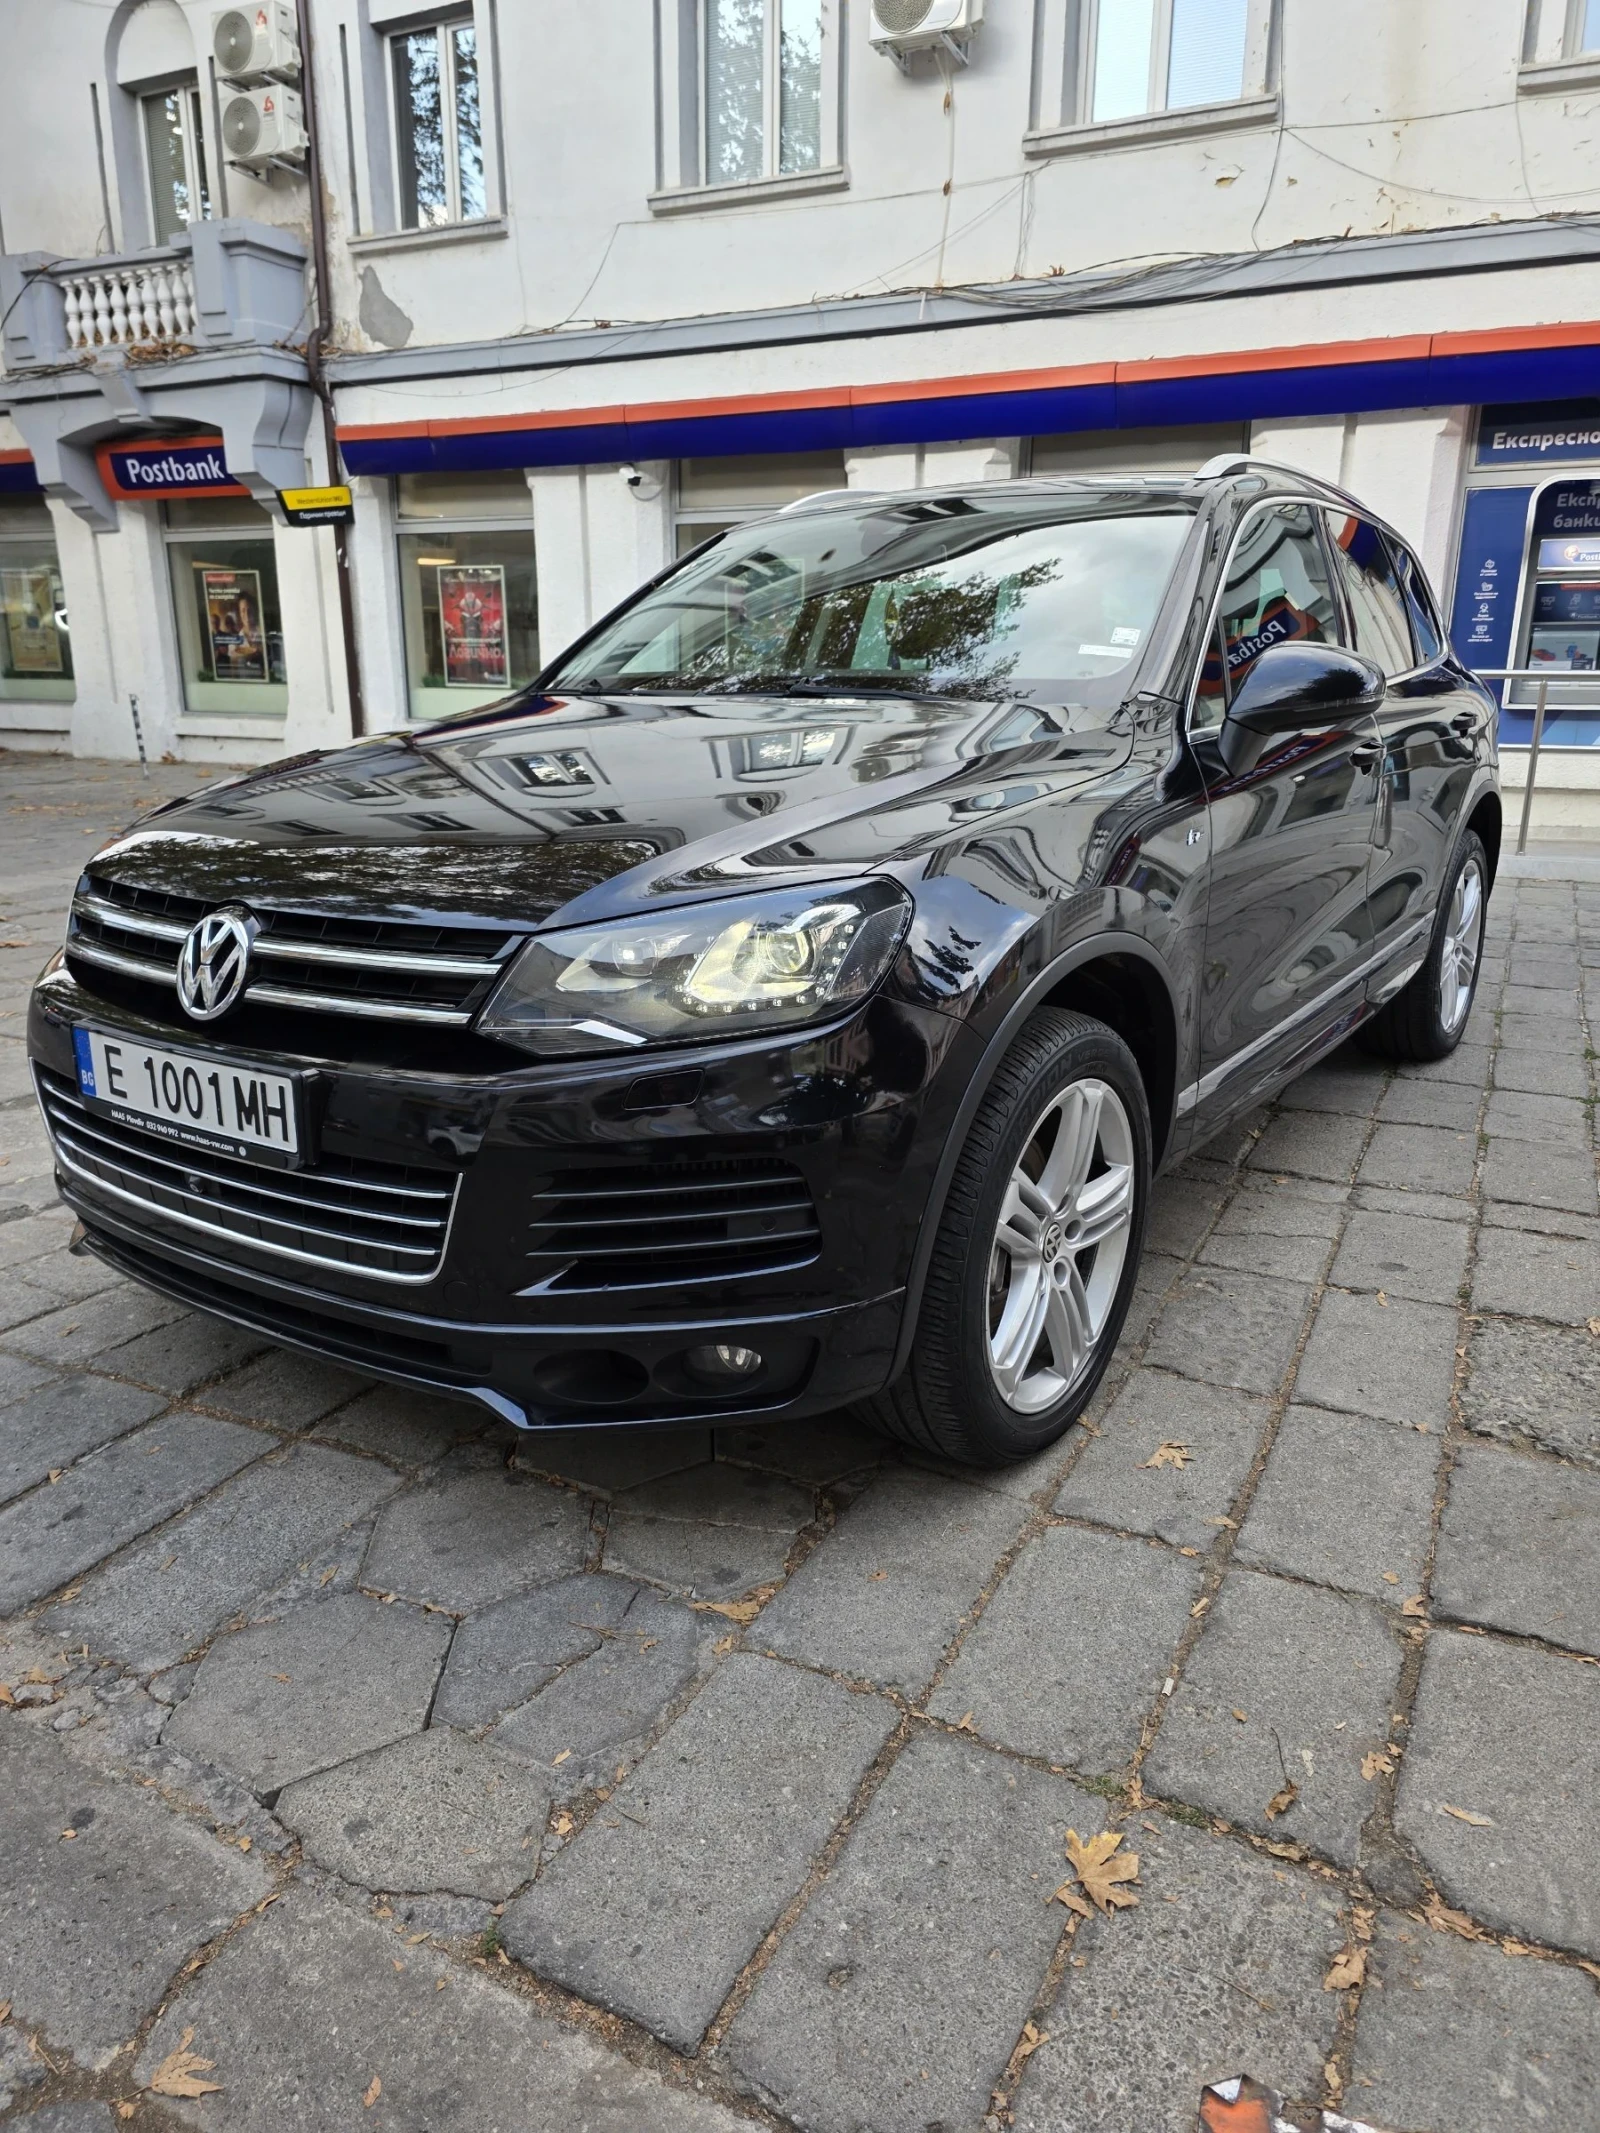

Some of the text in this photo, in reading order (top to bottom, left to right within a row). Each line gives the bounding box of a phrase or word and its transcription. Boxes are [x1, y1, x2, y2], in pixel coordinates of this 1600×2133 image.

[1492, 431, 1600, 452] Експресно
[125, 453, 225, 484] Postbank
[81, 1069, 95, 1087] BG
[104, 1043, 289, 1142] E 1001 MH
